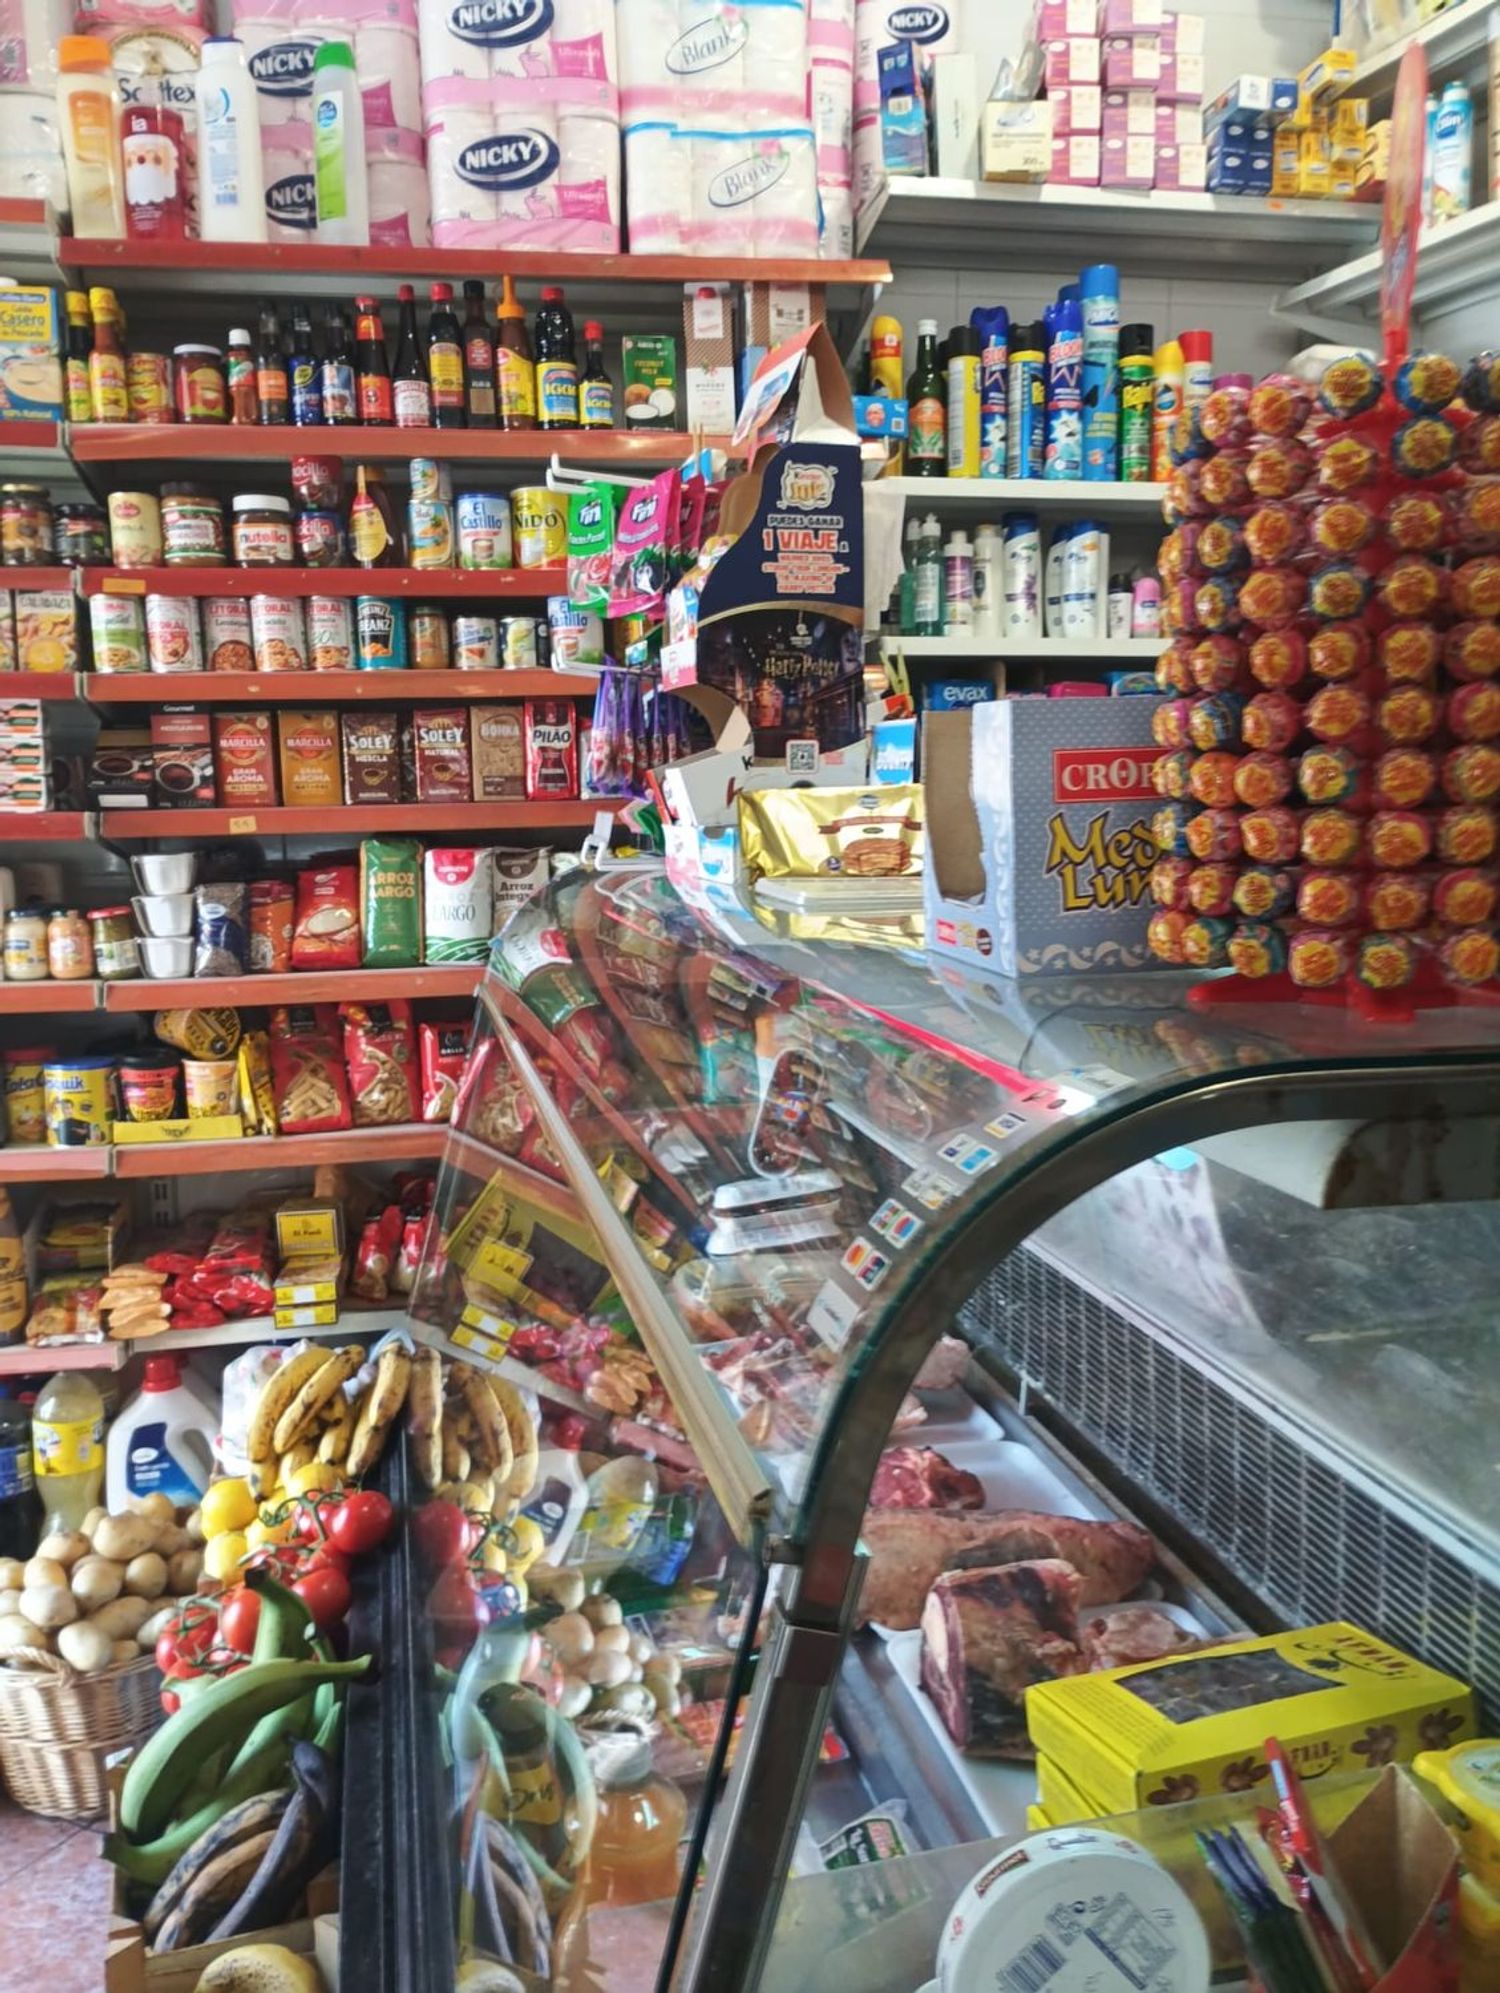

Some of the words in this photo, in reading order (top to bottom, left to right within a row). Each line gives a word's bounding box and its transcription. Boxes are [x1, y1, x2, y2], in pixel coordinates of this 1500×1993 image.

[459, 1, 527, 28] NICKY
[891, 12, 936, 28] NICKY
[682, 28, 739, 65] Blank
[252, 48, 317, 78] NICKY
[118, 77, 197, 103] Scttex
[465, 143, 538, 169] NICKY
[725, 160, 778, 198] Blank
[473, 502, 486, 516] El
[461, 515, 502, 529] Castillo
[240, 532, 288, 545] nutella
[764, 530, 773, 549] 1
[779, 530, 837, 550] VIAJE
[359, 618, 391, 631] BEANZ
[943, 684, 989, 701] evax
[220, 737, 266, 748] MARCILLA
[349, 734, 393, 749] SOLEY
[420, 727, 464, 743] SOLEY
[226, 774, 265, 783] AROMA
[501, 882, 535, 891] Arroz
